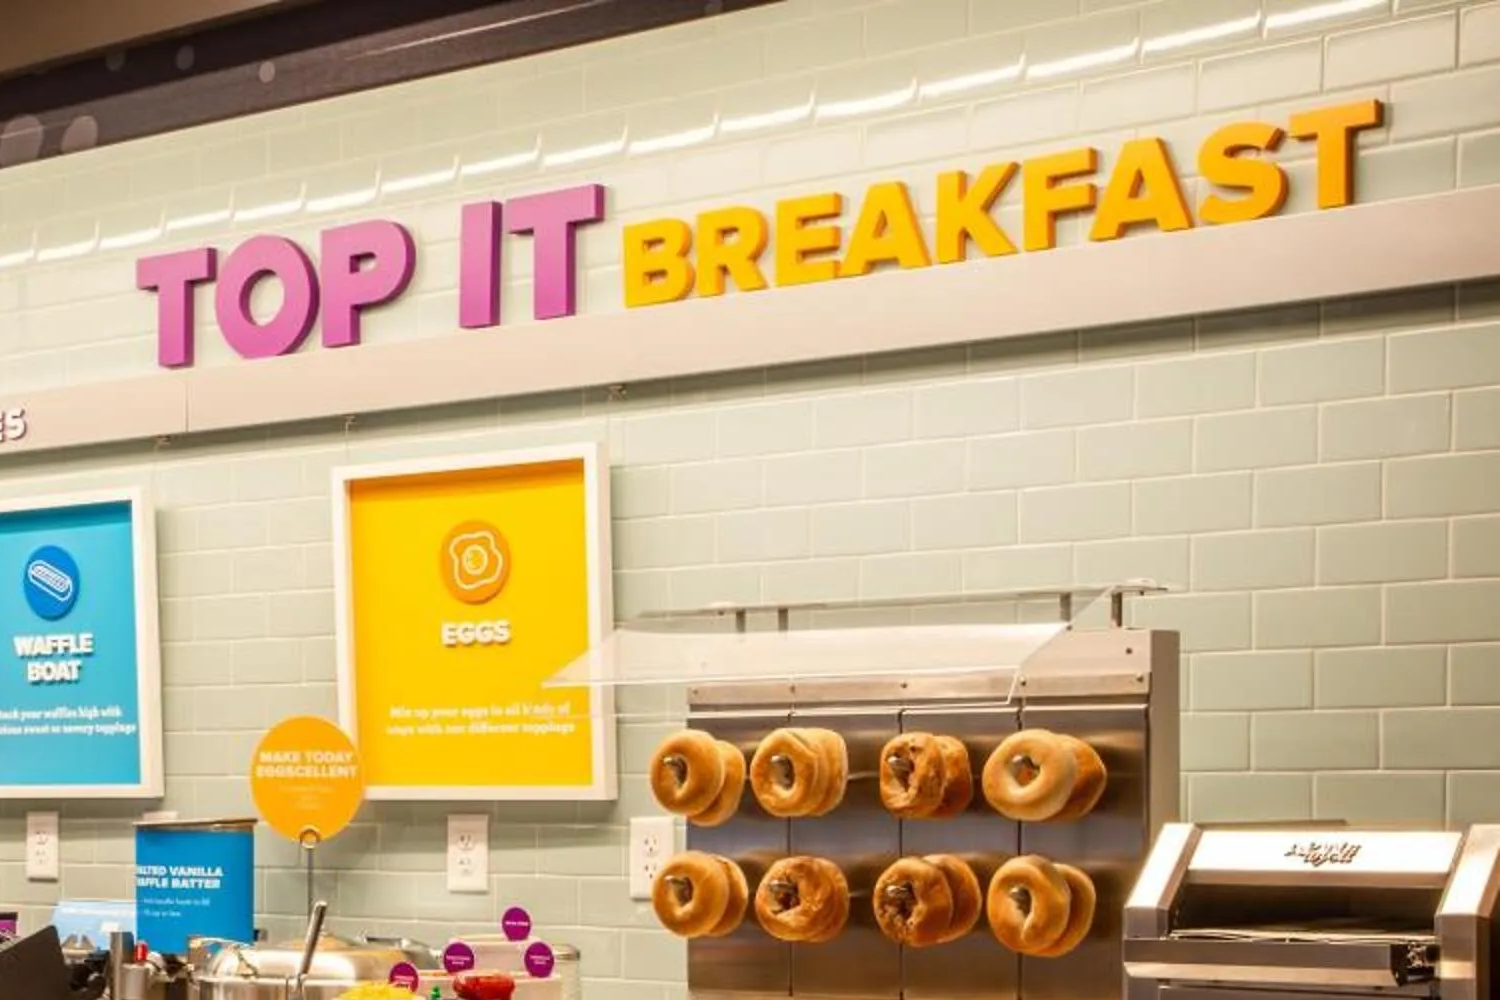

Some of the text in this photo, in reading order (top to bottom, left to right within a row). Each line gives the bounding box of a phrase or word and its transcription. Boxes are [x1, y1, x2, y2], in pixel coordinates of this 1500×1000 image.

[136, 98, 1383, 368] TOP IT BREAKFAST
[441, 619, 512, 646] EGGS
[13, 633, 95, 658] WAFFLE
[27, 659, 83, 685] BOAT
[169, 865, 224, 877] VANILLA
[171, 878, 221, 890] BATTER
